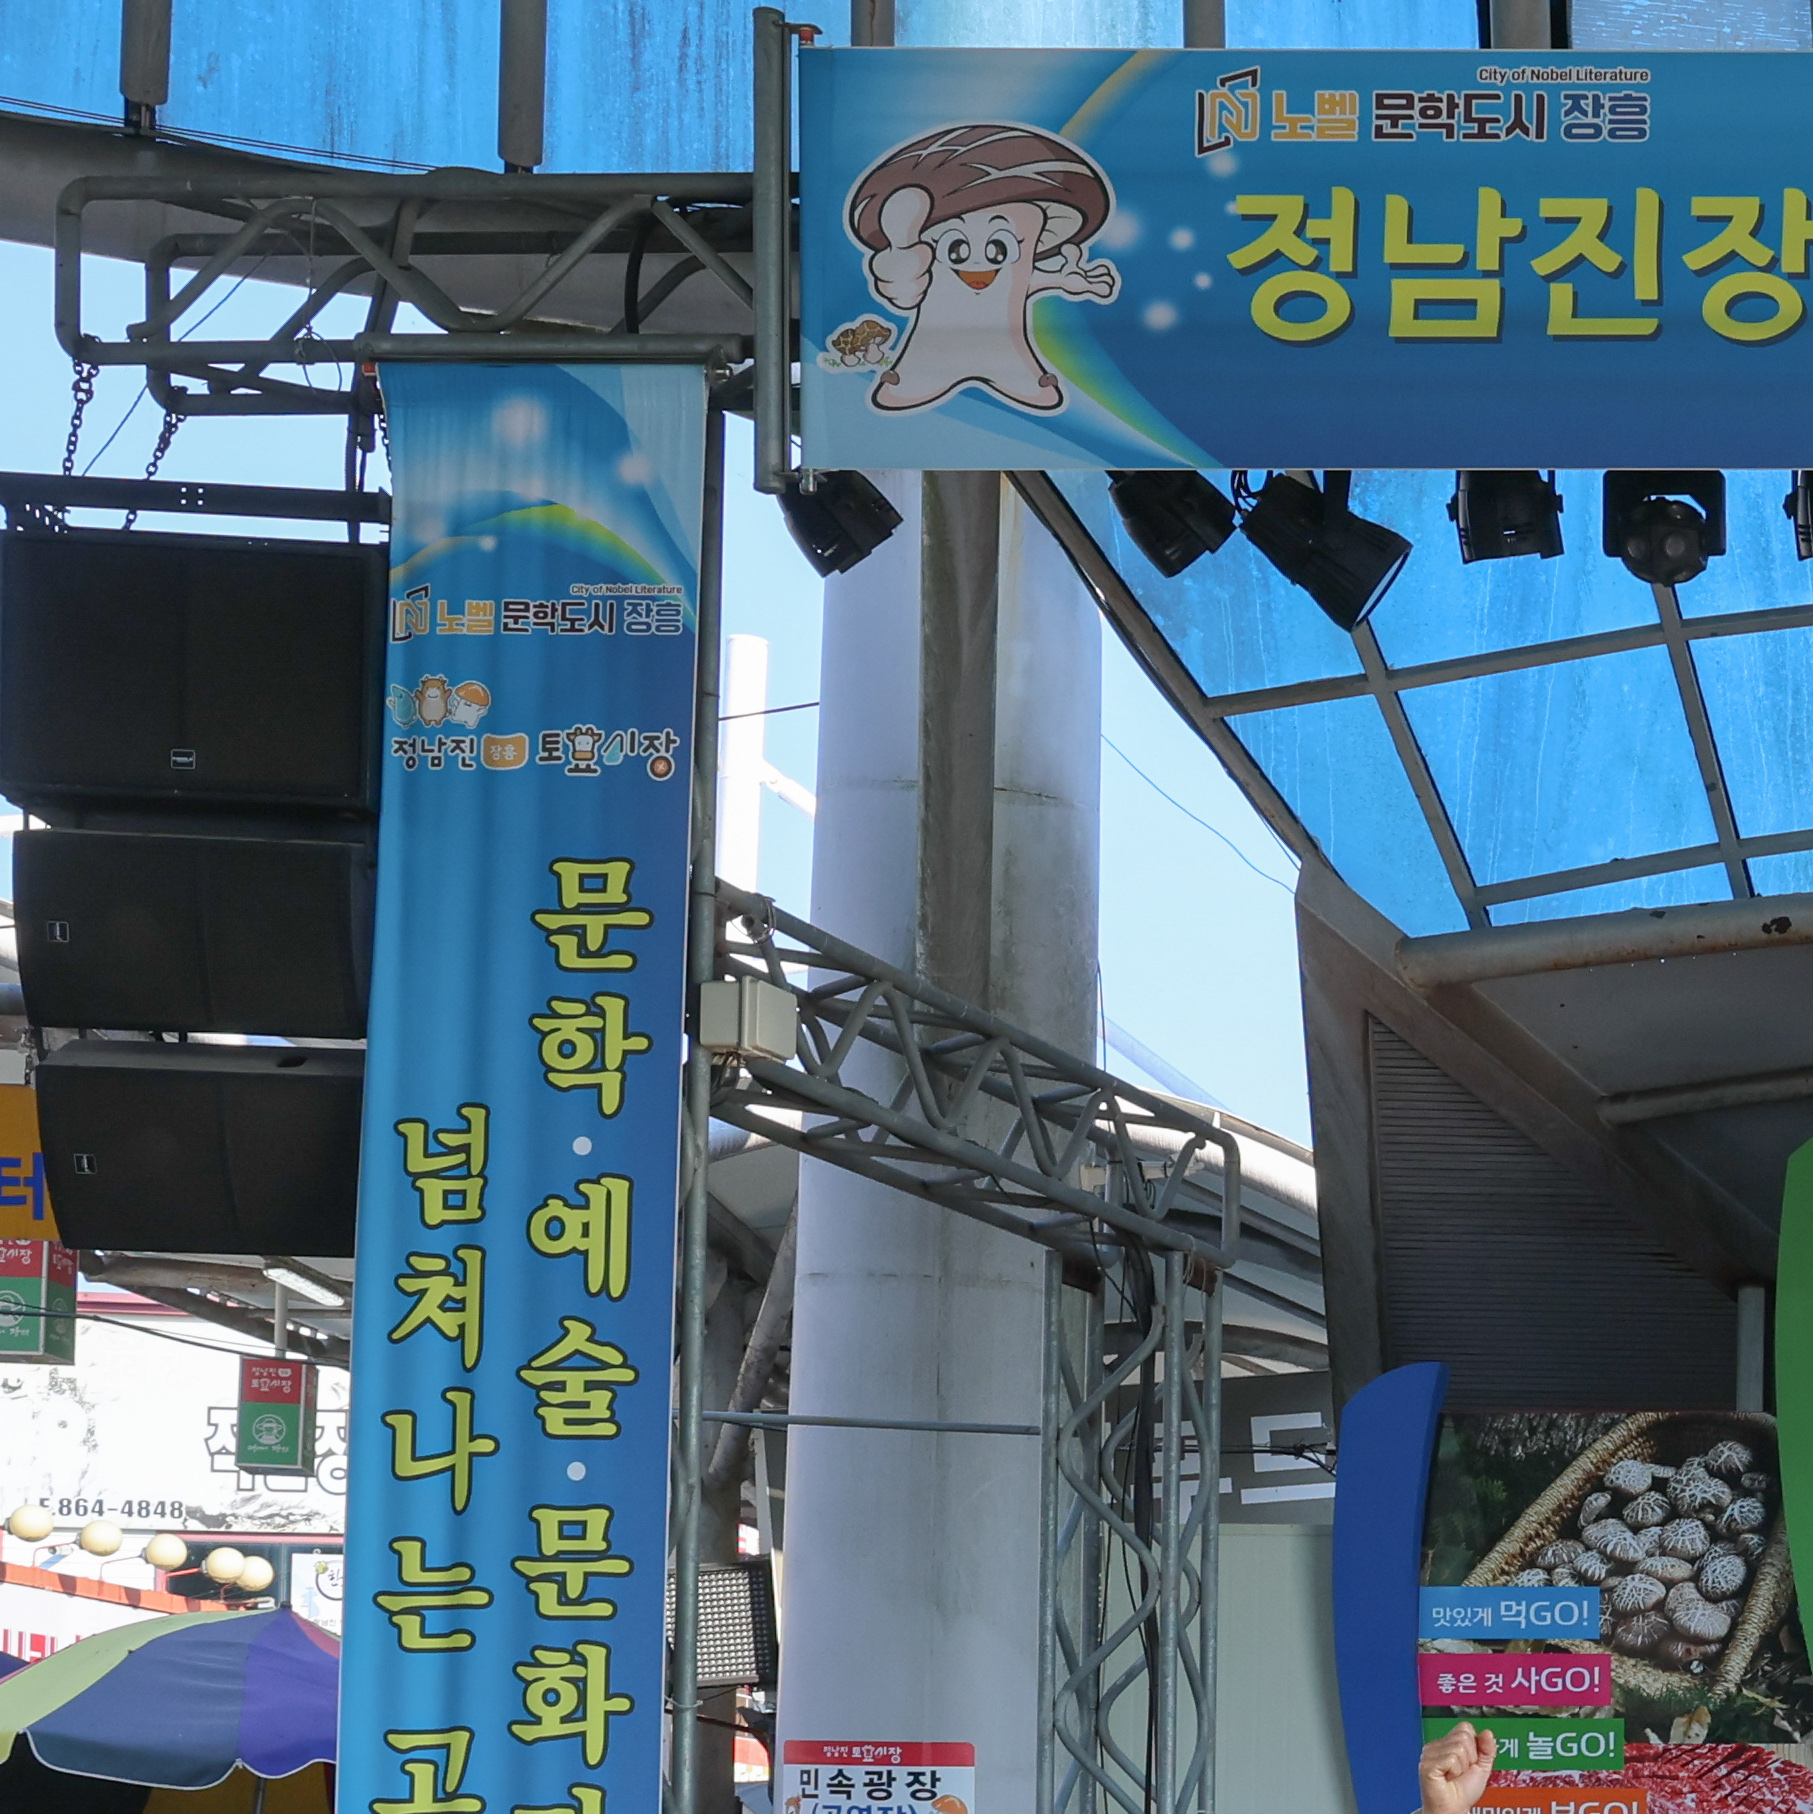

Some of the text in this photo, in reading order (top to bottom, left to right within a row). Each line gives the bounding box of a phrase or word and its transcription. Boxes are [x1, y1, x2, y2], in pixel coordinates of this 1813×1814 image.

[1479, 66, 1649, 83] City of Nobel Literature
[1271, 90, 1650, 141] 노벨 문학도시 장흥
[605, 585, 632, 594] Nobel
[635, 585, 682, 594] Literature
[437, 599, 683, 635] 노벨 문학도시 장흥
[393, 736, 476, 770] 정남진
[372, 1103, 499, 1654] 넘쳐나는
[1432, 1601, 1588, 1629] 맛있게 먹GO!
[1437, 1666, 1600, 1694] 좋은 것 사GO!
[1526, 1732, 1615, 1760] 놀GO!
